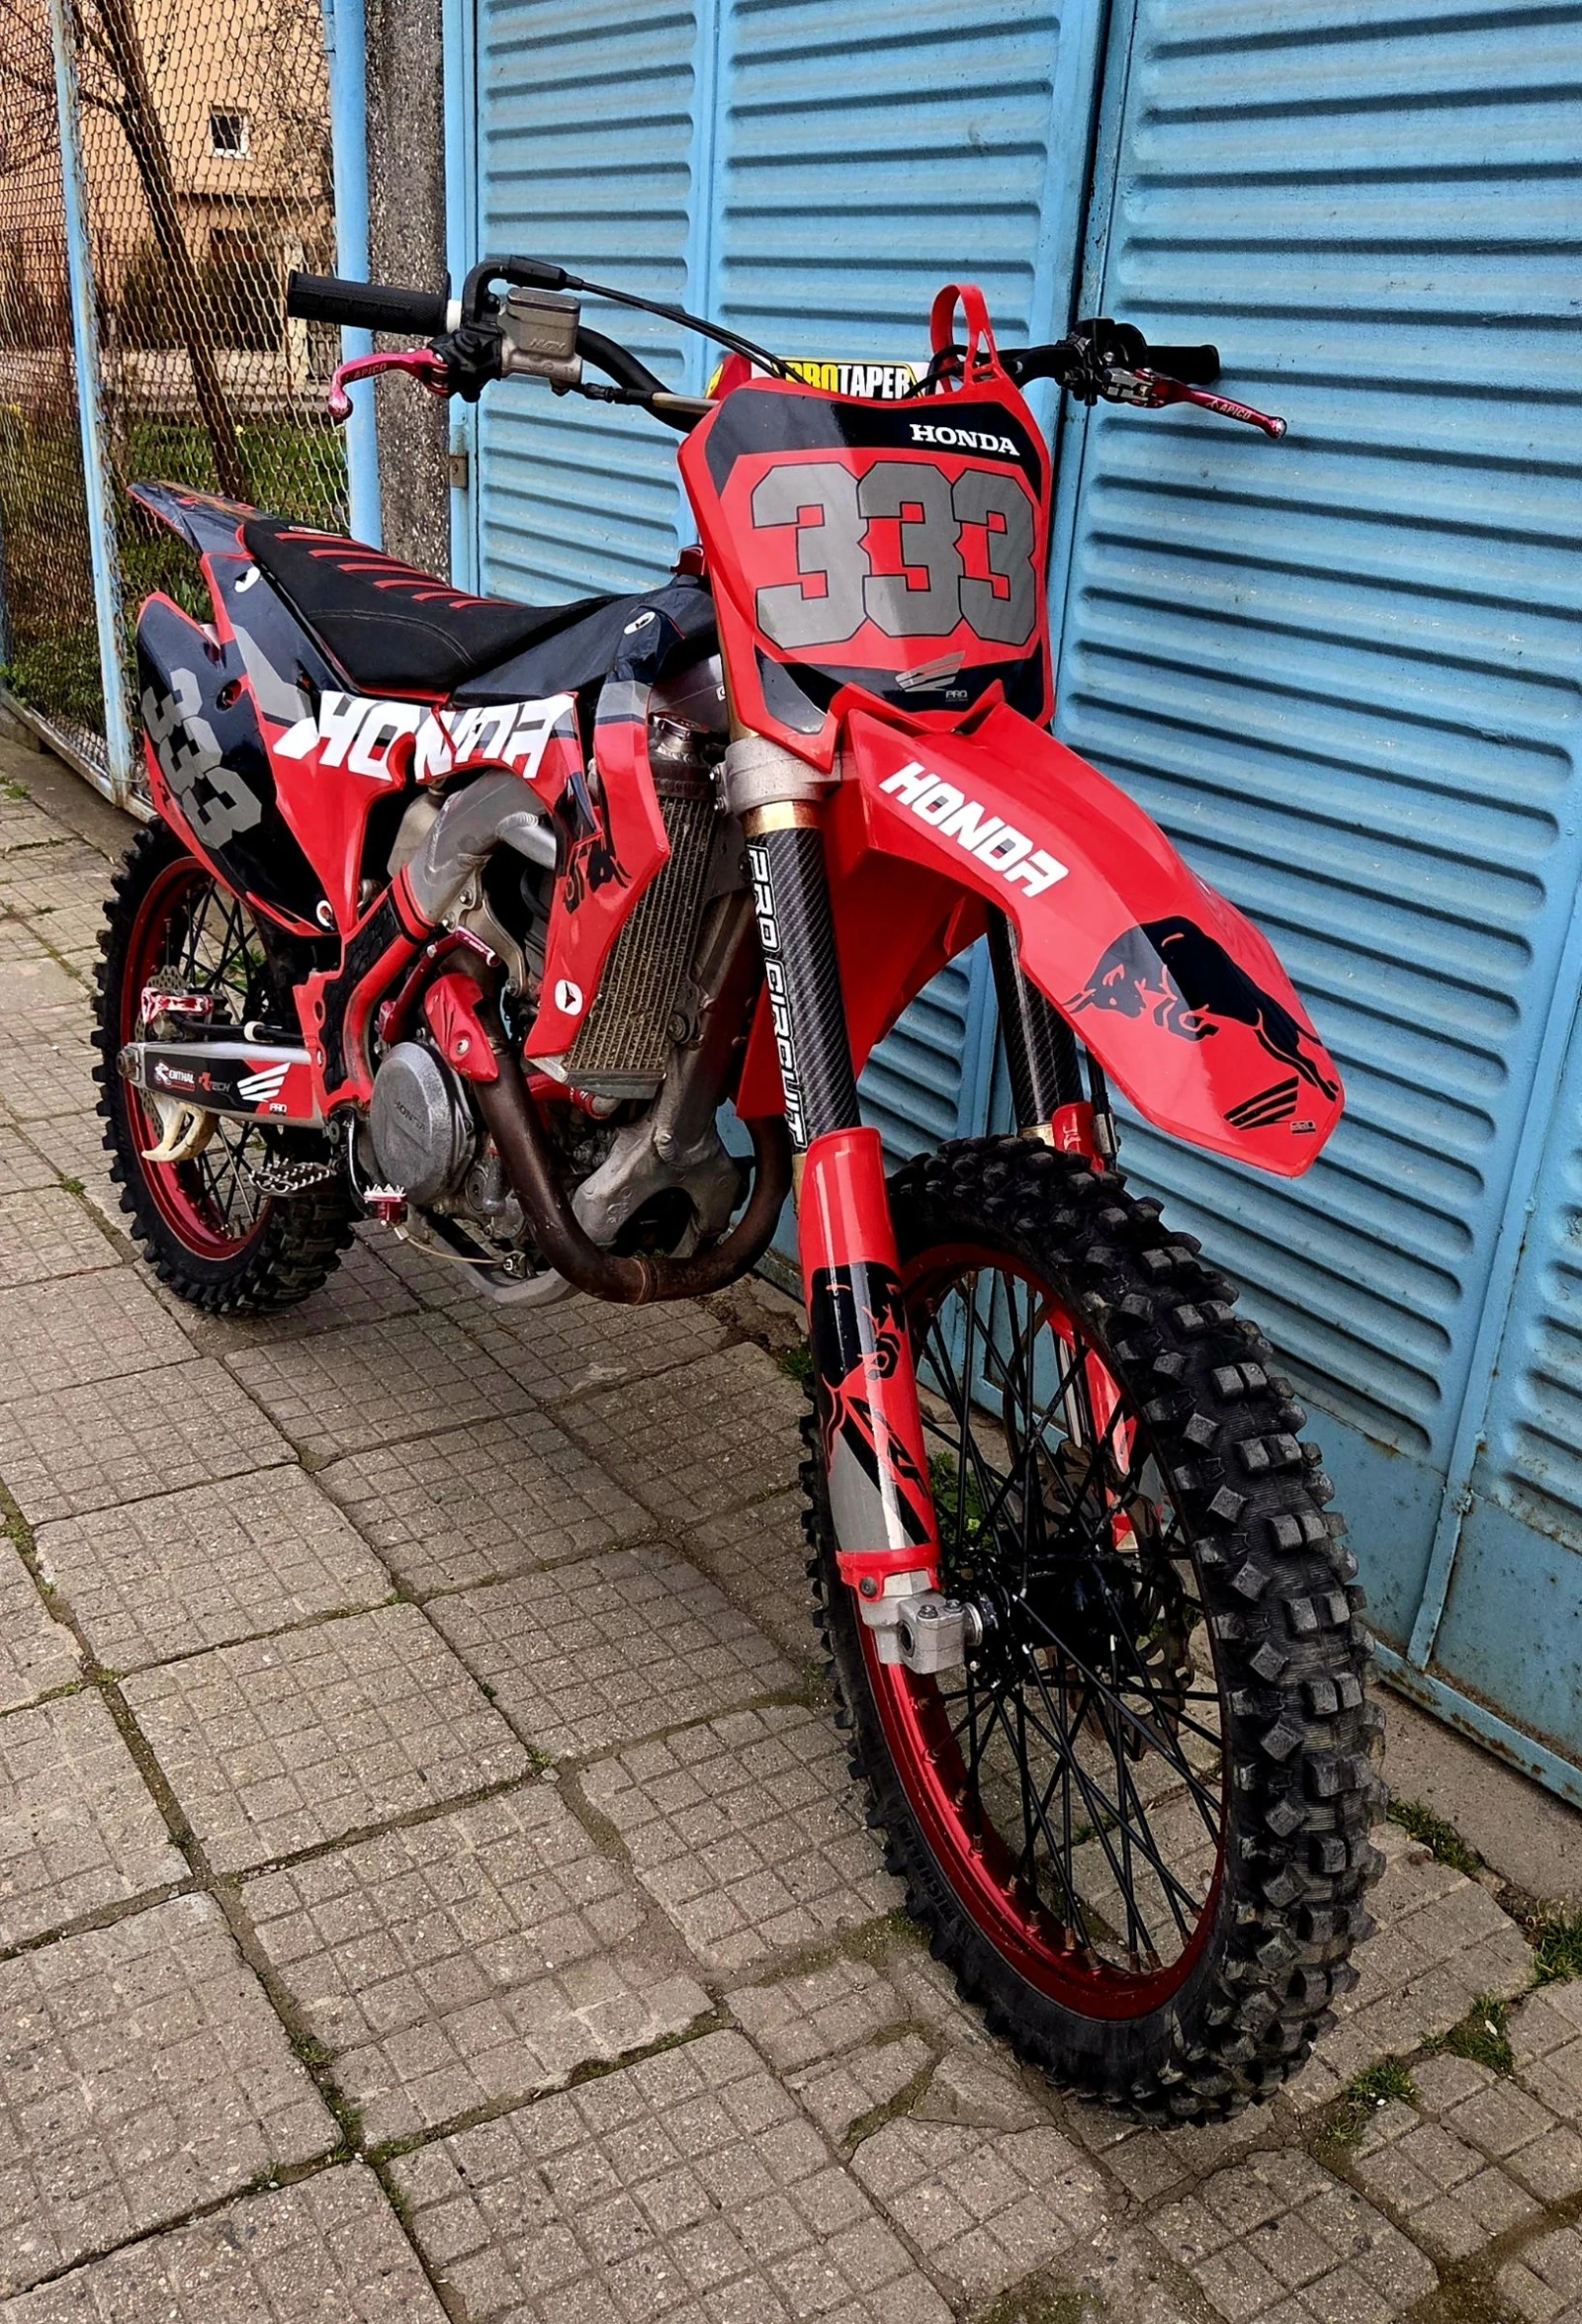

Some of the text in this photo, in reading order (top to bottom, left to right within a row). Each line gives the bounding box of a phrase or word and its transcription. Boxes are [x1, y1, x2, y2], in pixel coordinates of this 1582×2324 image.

[354, 363, 387, 379] APICO
[1218, 403, 1252, 420] APICO
[910, 423, 1020, 457] HONDA
[751, 461, 1035, 649] 333
[273, 690, 576, 781] HONDA
[945, 690, 968, 699] PRO
[141, 667, 262, 849] 333
[878, 760, 1070, 898] HONDA
[748, 846, 808, 1148] PRO CIRCUIT
